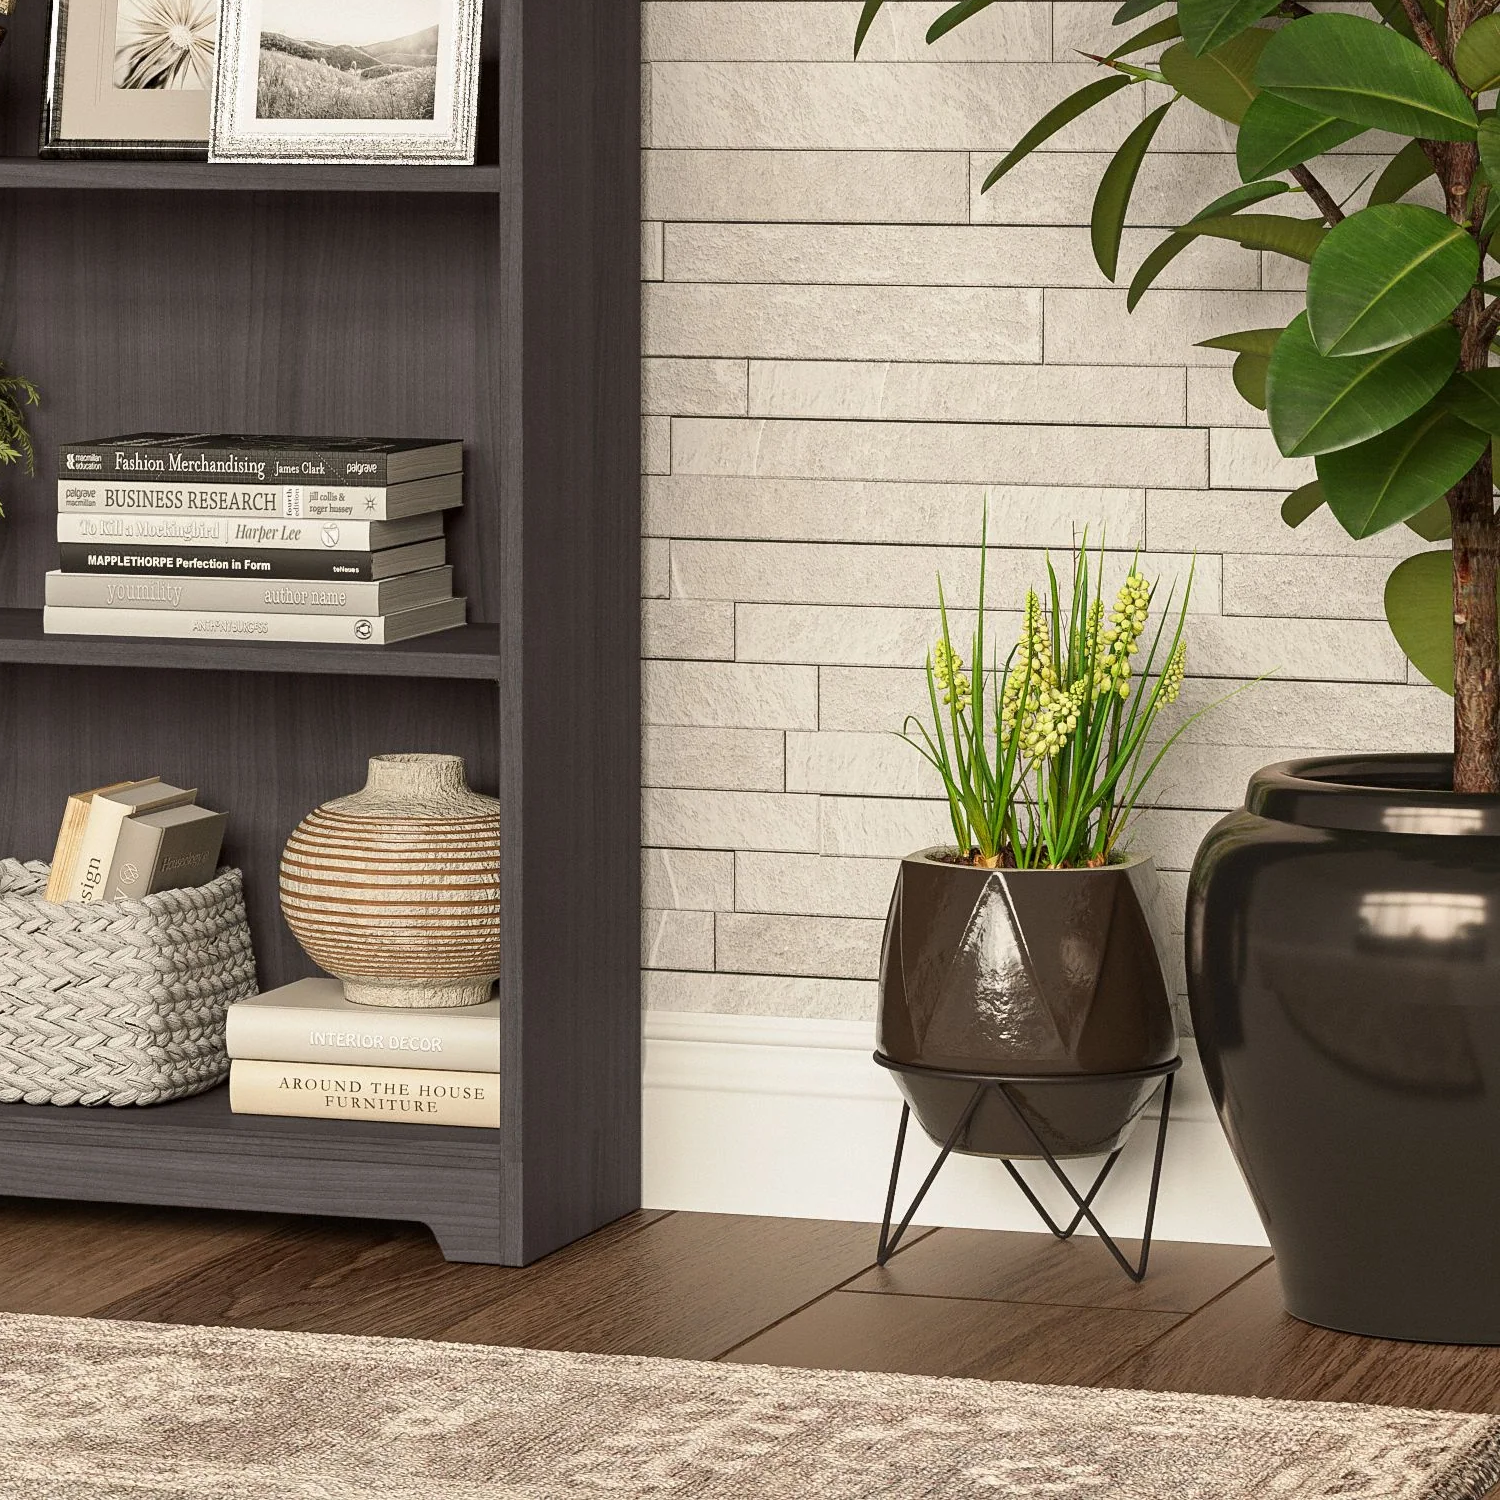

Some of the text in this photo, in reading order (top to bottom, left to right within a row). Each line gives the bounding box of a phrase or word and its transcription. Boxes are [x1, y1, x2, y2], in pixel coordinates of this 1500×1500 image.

[75, 462, 102, 470] education
[114, 451, 326, 480] Fashion Merchandising James Clark
[346, 463, 378, 477] palgrave
[65, 487, 96, 500] palgrave
[104, 489, 277, 511] BUSINESS RESEARCH
[309, 491, 346, 503] jill collis &
[309, 503, 353, 515] roger hussey
[79, 518, 302, 543] To Kill a Mockingbird Harper Lee
[87, 554, 271, 571] MAPPLETHORPE Perfection in Form
[264, 586, 308, 605] author
[311, 591, 347, 606] name
[308, 1031, 443, 1052] INTERIOR DECOR
[278, 1076, 485, 1100] AROUND THE HOUSE
[324, 1095, 438, 1113] FURNITURE
